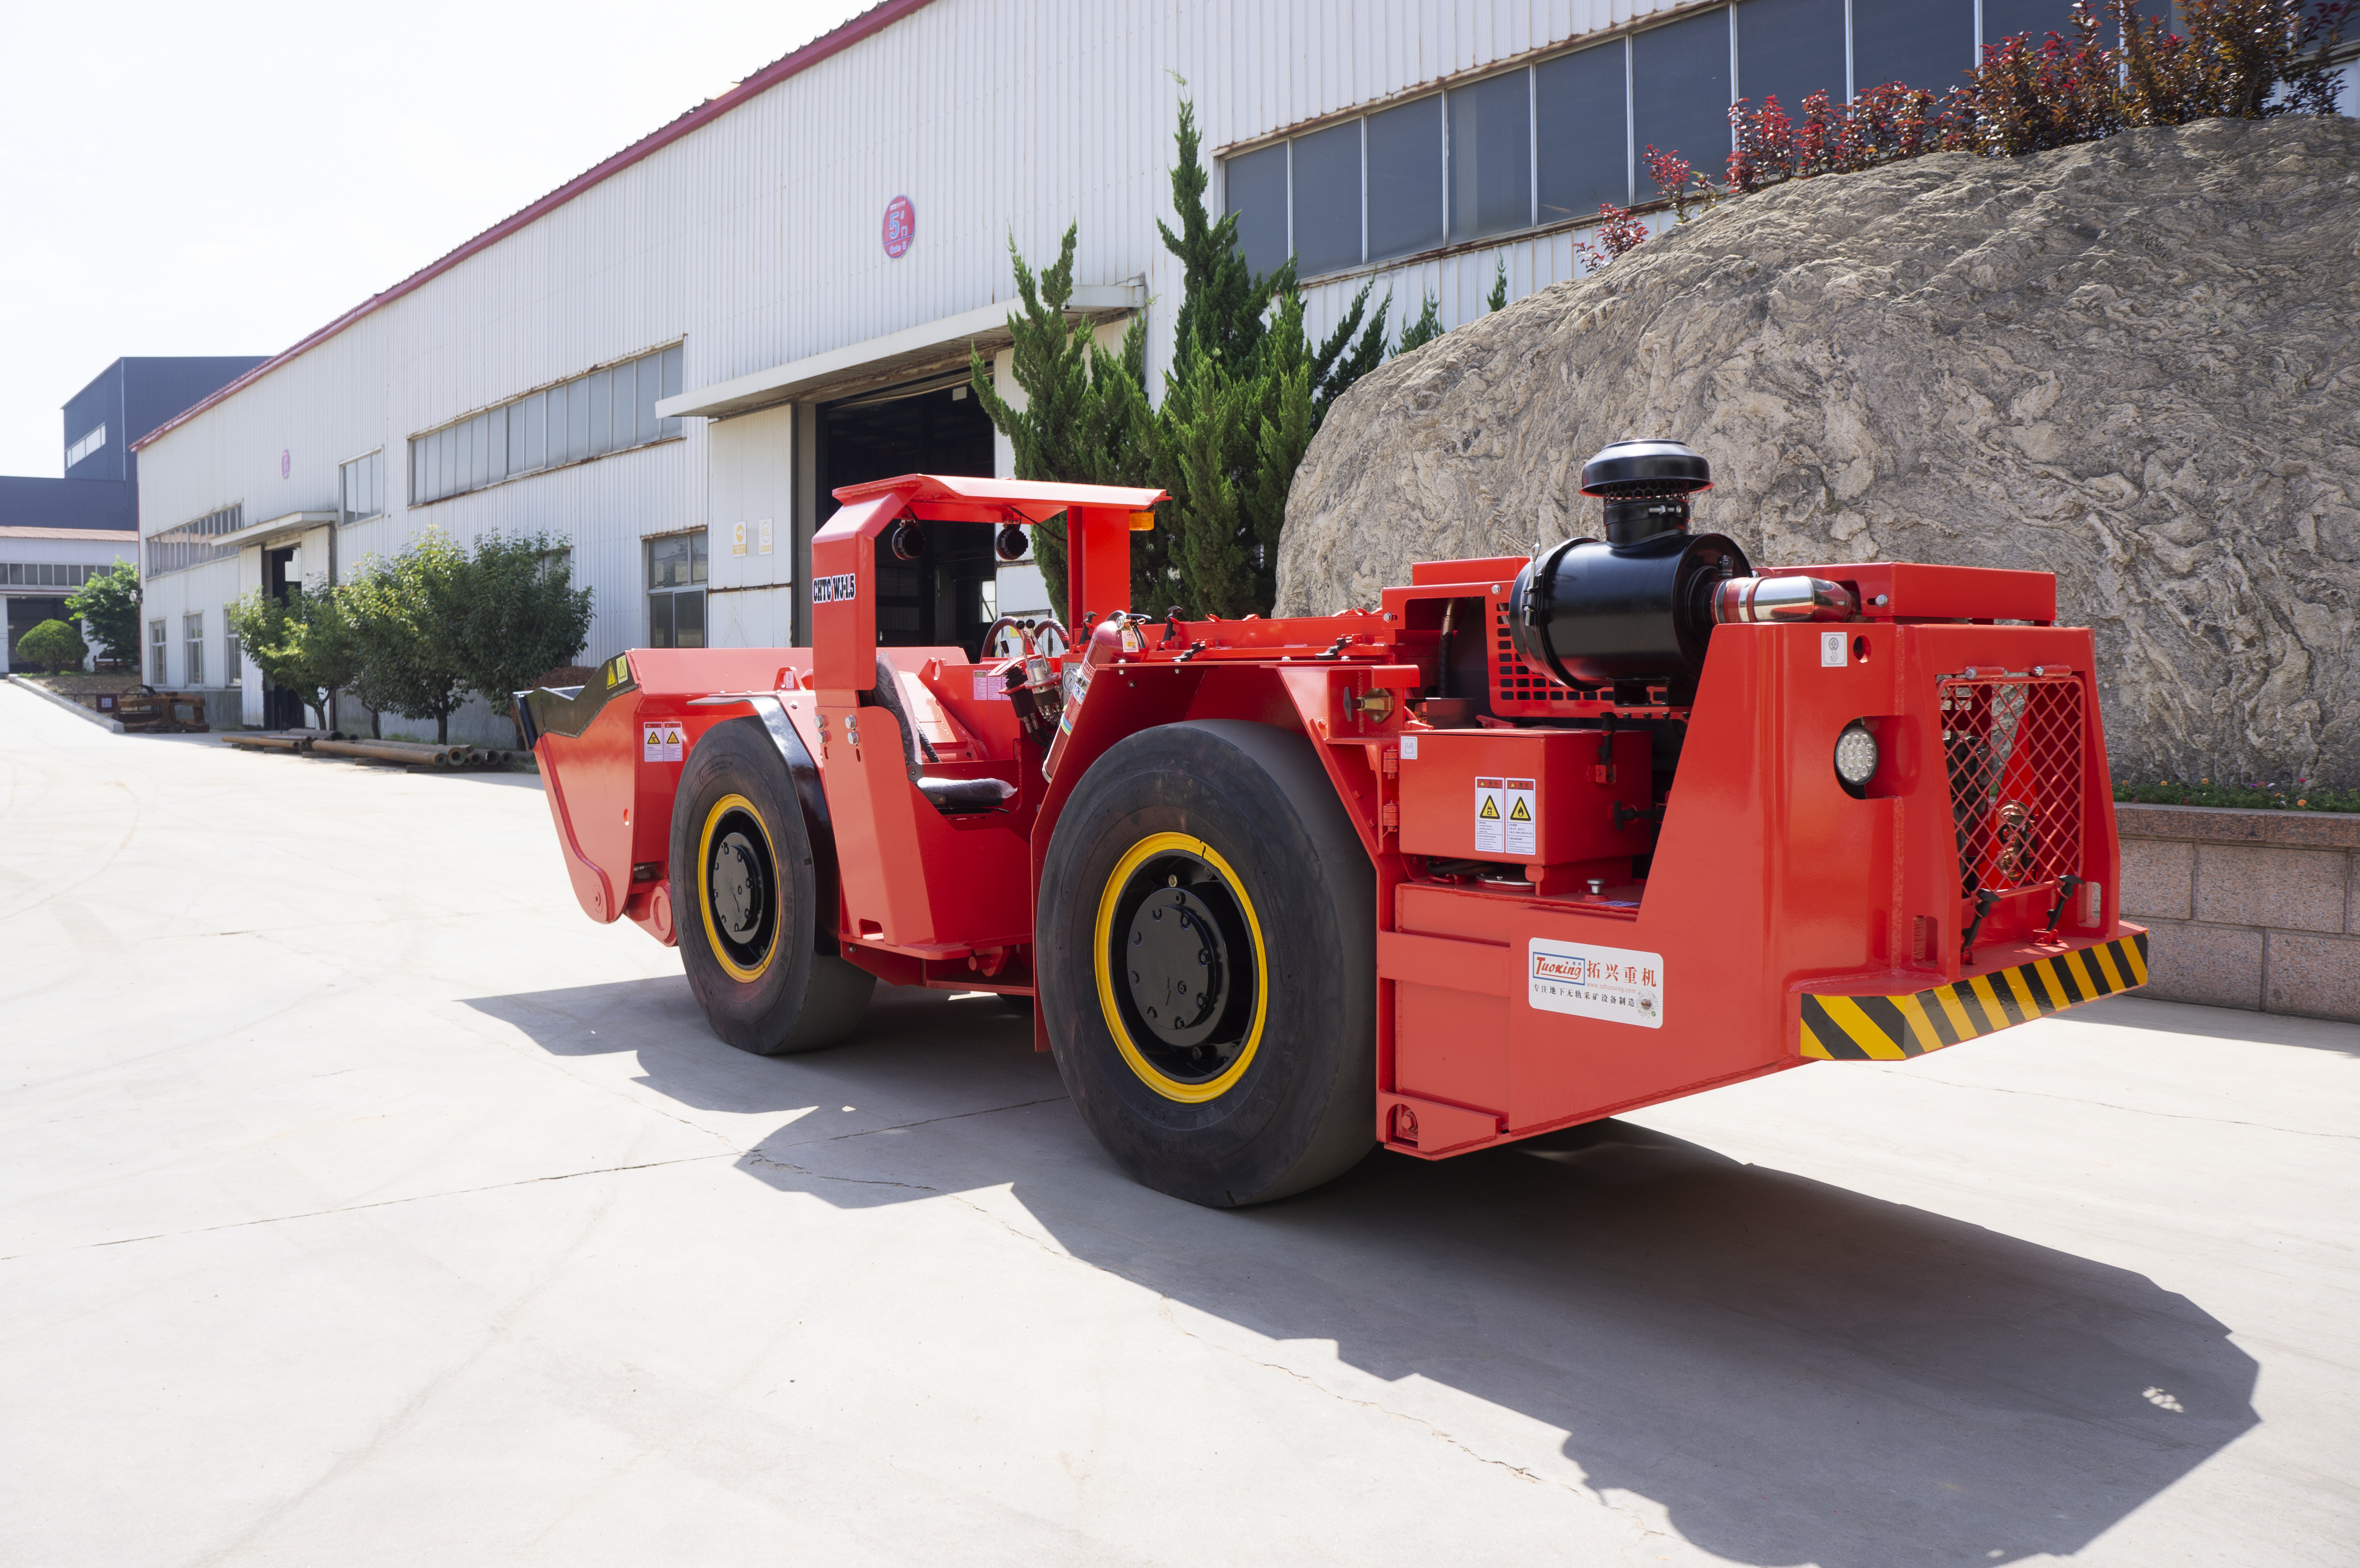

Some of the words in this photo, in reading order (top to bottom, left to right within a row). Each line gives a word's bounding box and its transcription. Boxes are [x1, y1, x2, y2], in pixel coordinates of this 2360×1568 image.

[813, 578, 831, 602] CHTC
[833, 575, 855, 600] WJ-1.5
[1536, 956, 1582, 980] Tuoxing
[1586, 960, 1657, 987] 拓兴重机
[1533, 983, 1635, 1007] 专注地下无轨采矿设备制造
[1586, 982, 1636, 993] www.sdtuoxing.com
